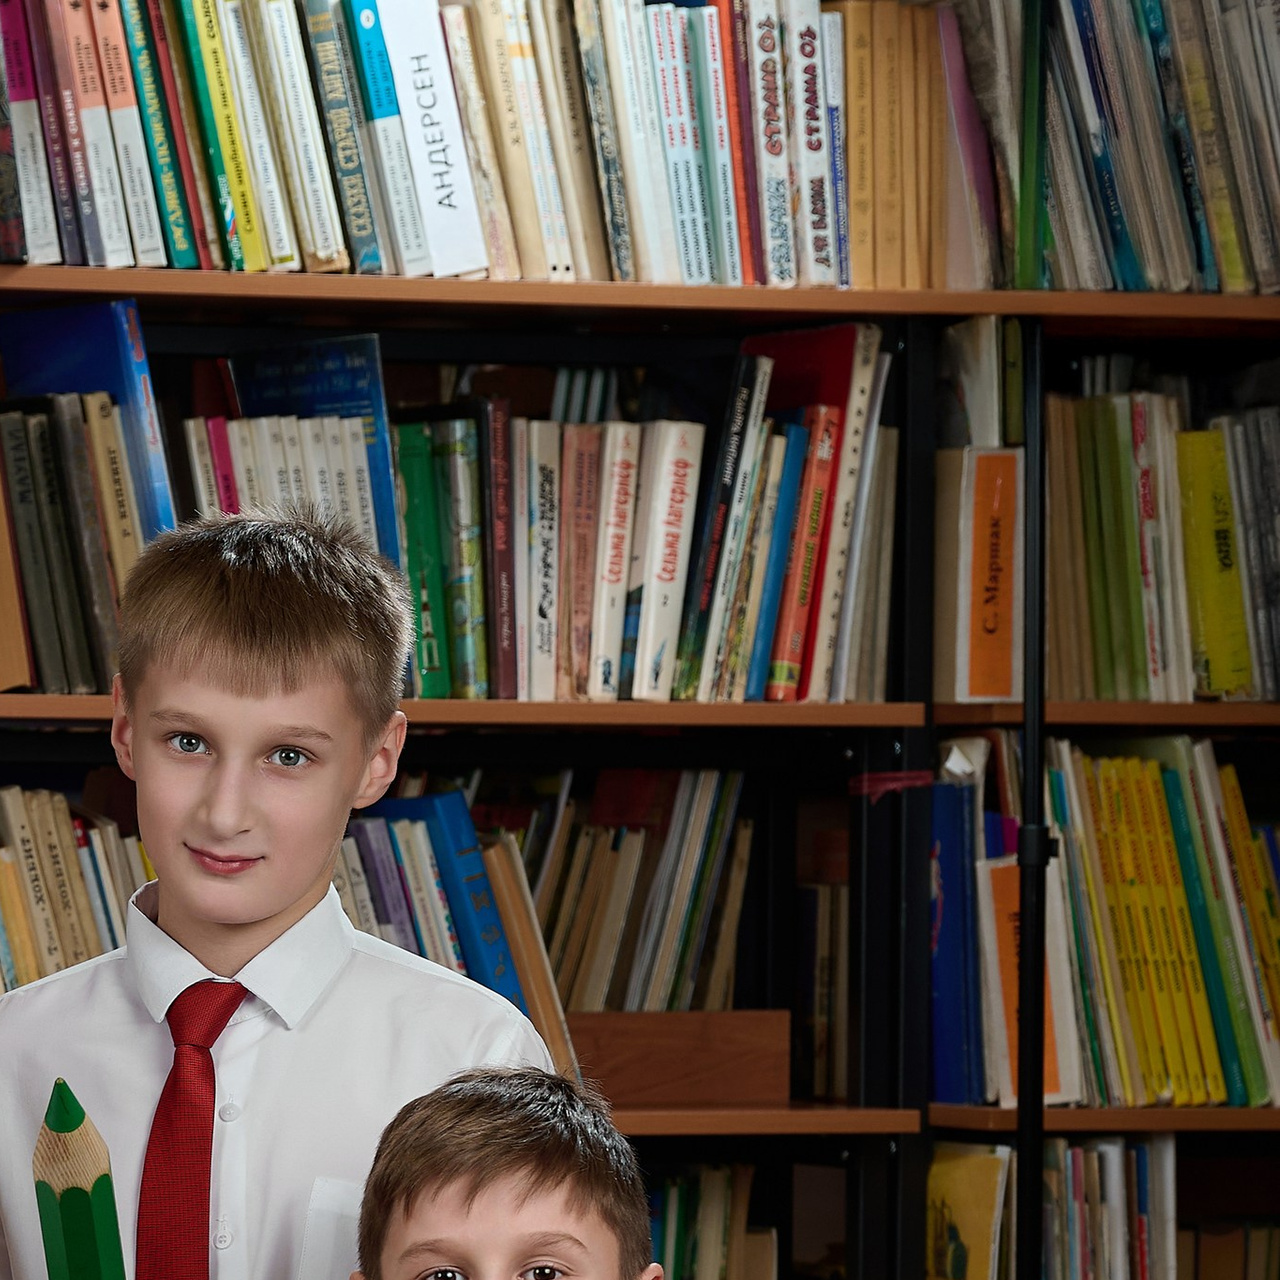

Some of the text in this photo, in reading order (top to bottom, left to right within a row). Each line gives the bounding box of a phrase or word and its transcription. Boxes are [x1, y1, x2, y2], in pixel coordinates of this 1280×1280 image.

[313, 39, 346, 104] АНГЛИИ
[799, 62, 823, 152] СТРАНА
[326, 105, 360, 172] СТАРОЙ
[408, 51, 461, 212] АНДЕРСЕН
[340, 172, 375, 238] СКАЗКИ
[5, 426, 35, 507] МАУГЛИ
[106, 445, 129, 521] КИПЛИНГ
[606, 458, 635, 529] Лагерлёф
[661, 457, 694, 529] Лагерлёф
[601, 531, 625, 585] Сельма
[655, 530, 679, 583] Сельма
[982, 515, 1005, 634] С. Маршак
[19, 834, 46, 906] ХОББИТ
[46, 841, 72, 911] ХОББИТ
